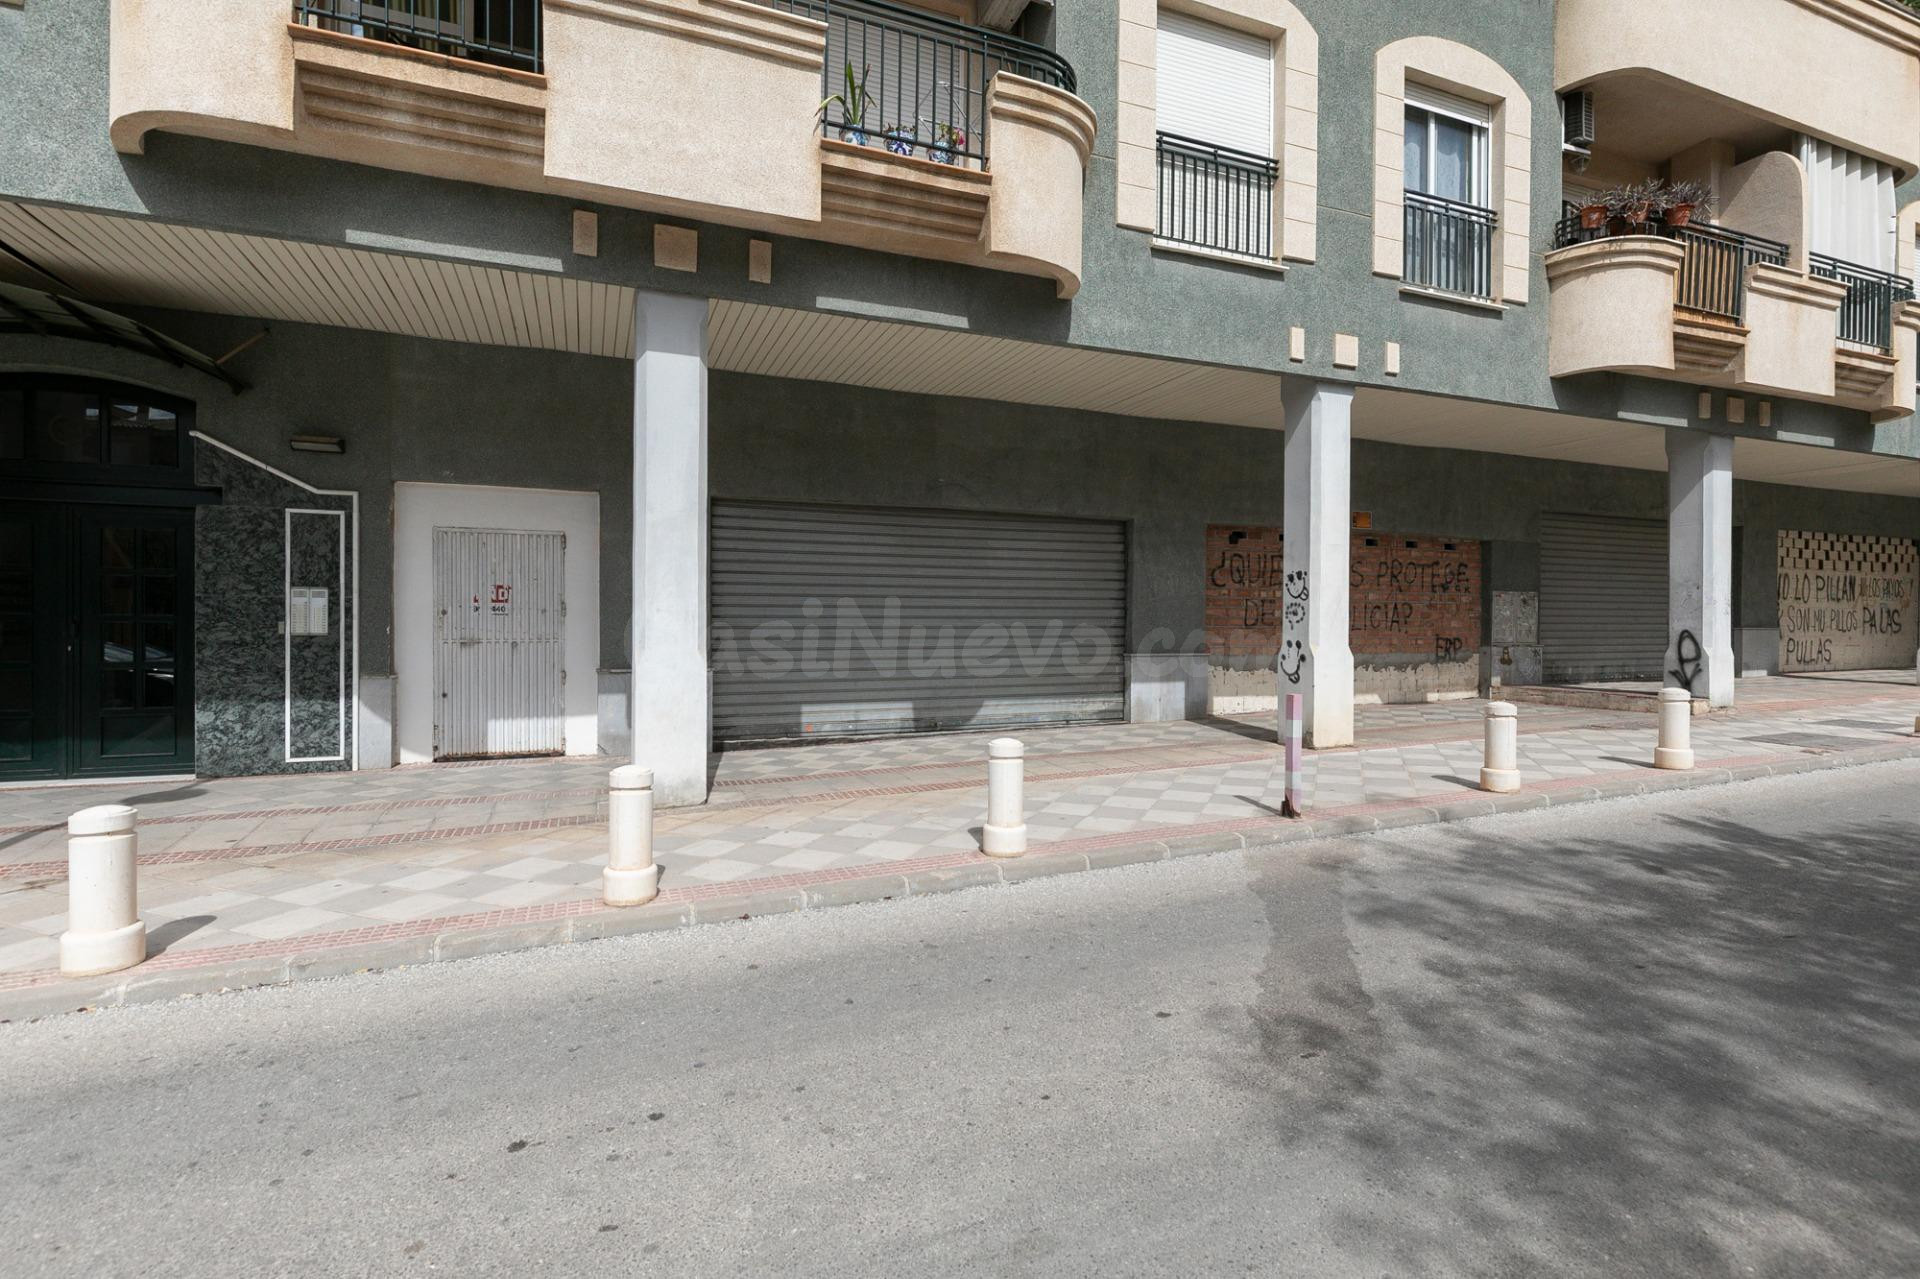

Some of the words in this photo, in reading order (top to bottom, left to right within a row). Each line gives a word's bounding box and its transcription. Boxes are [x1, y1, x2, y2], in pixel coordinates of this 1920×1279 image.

[1376, 558, 1468, 592] PROTEGE
[1815, 575, 1856, 603] PILLAN
[1245, 598, 1276, 627] DE
[1787, 604, 1811, 634] SON
[1785, 637, 1833, 666] PULLAS
